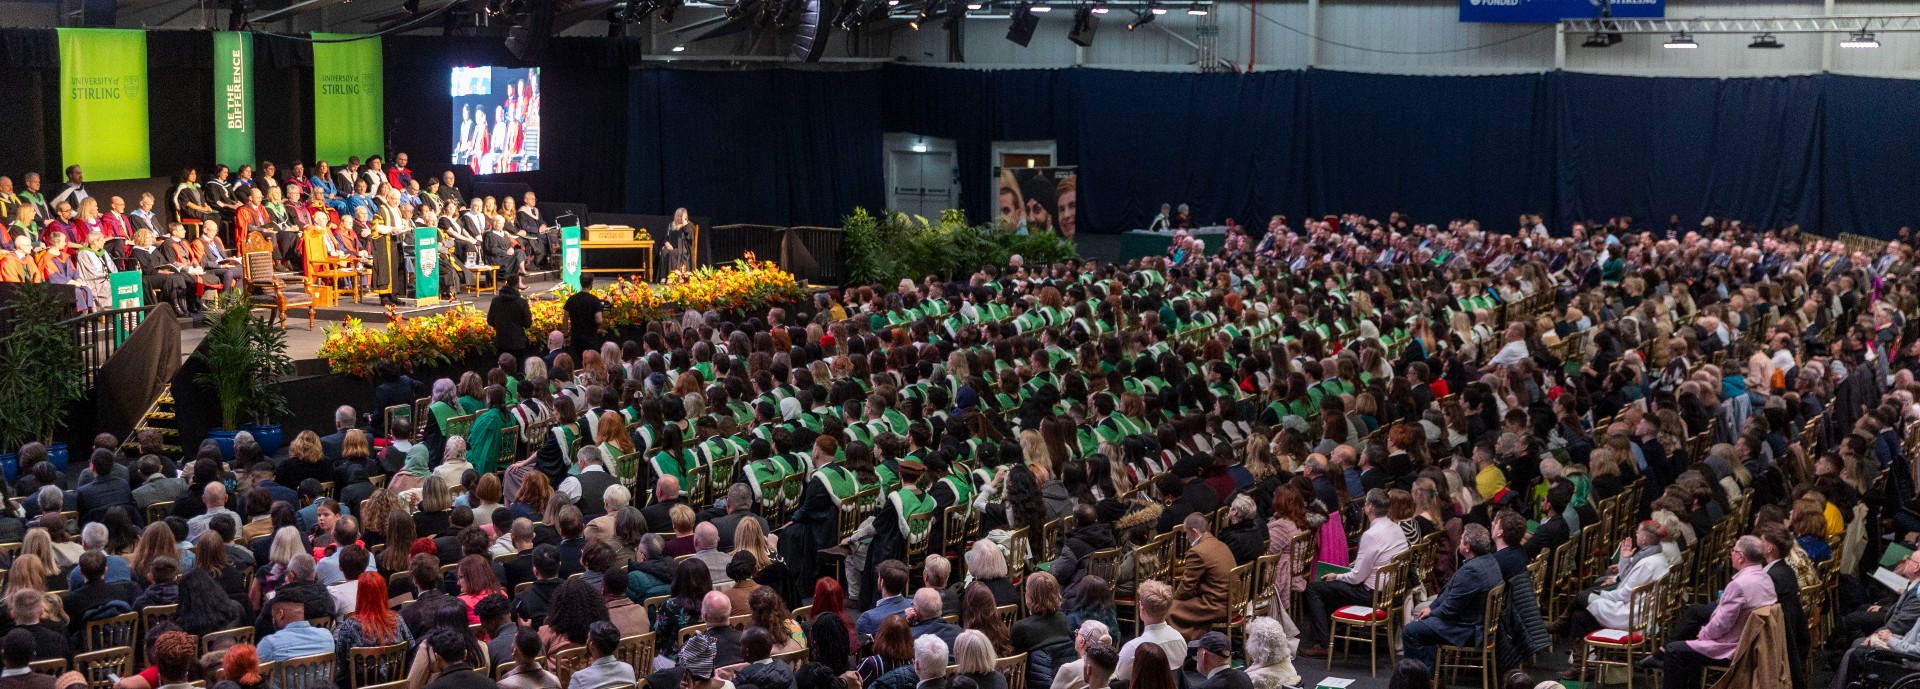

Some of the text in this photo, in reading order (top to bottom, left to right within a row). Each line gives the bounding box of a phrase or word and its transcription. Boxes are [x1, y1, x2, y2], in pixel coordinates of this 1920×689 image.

[71, 77, 119, 85] UNIVERSITY of
[322, 74, 353, 82] UNIVERSITY
[72, 87, 120, 99] STIRLING
[232, 50, 242, 128] DIFFERENCE
[322, 84, 359, 95] STIRLING
[228, 112, 235, 128] BE
